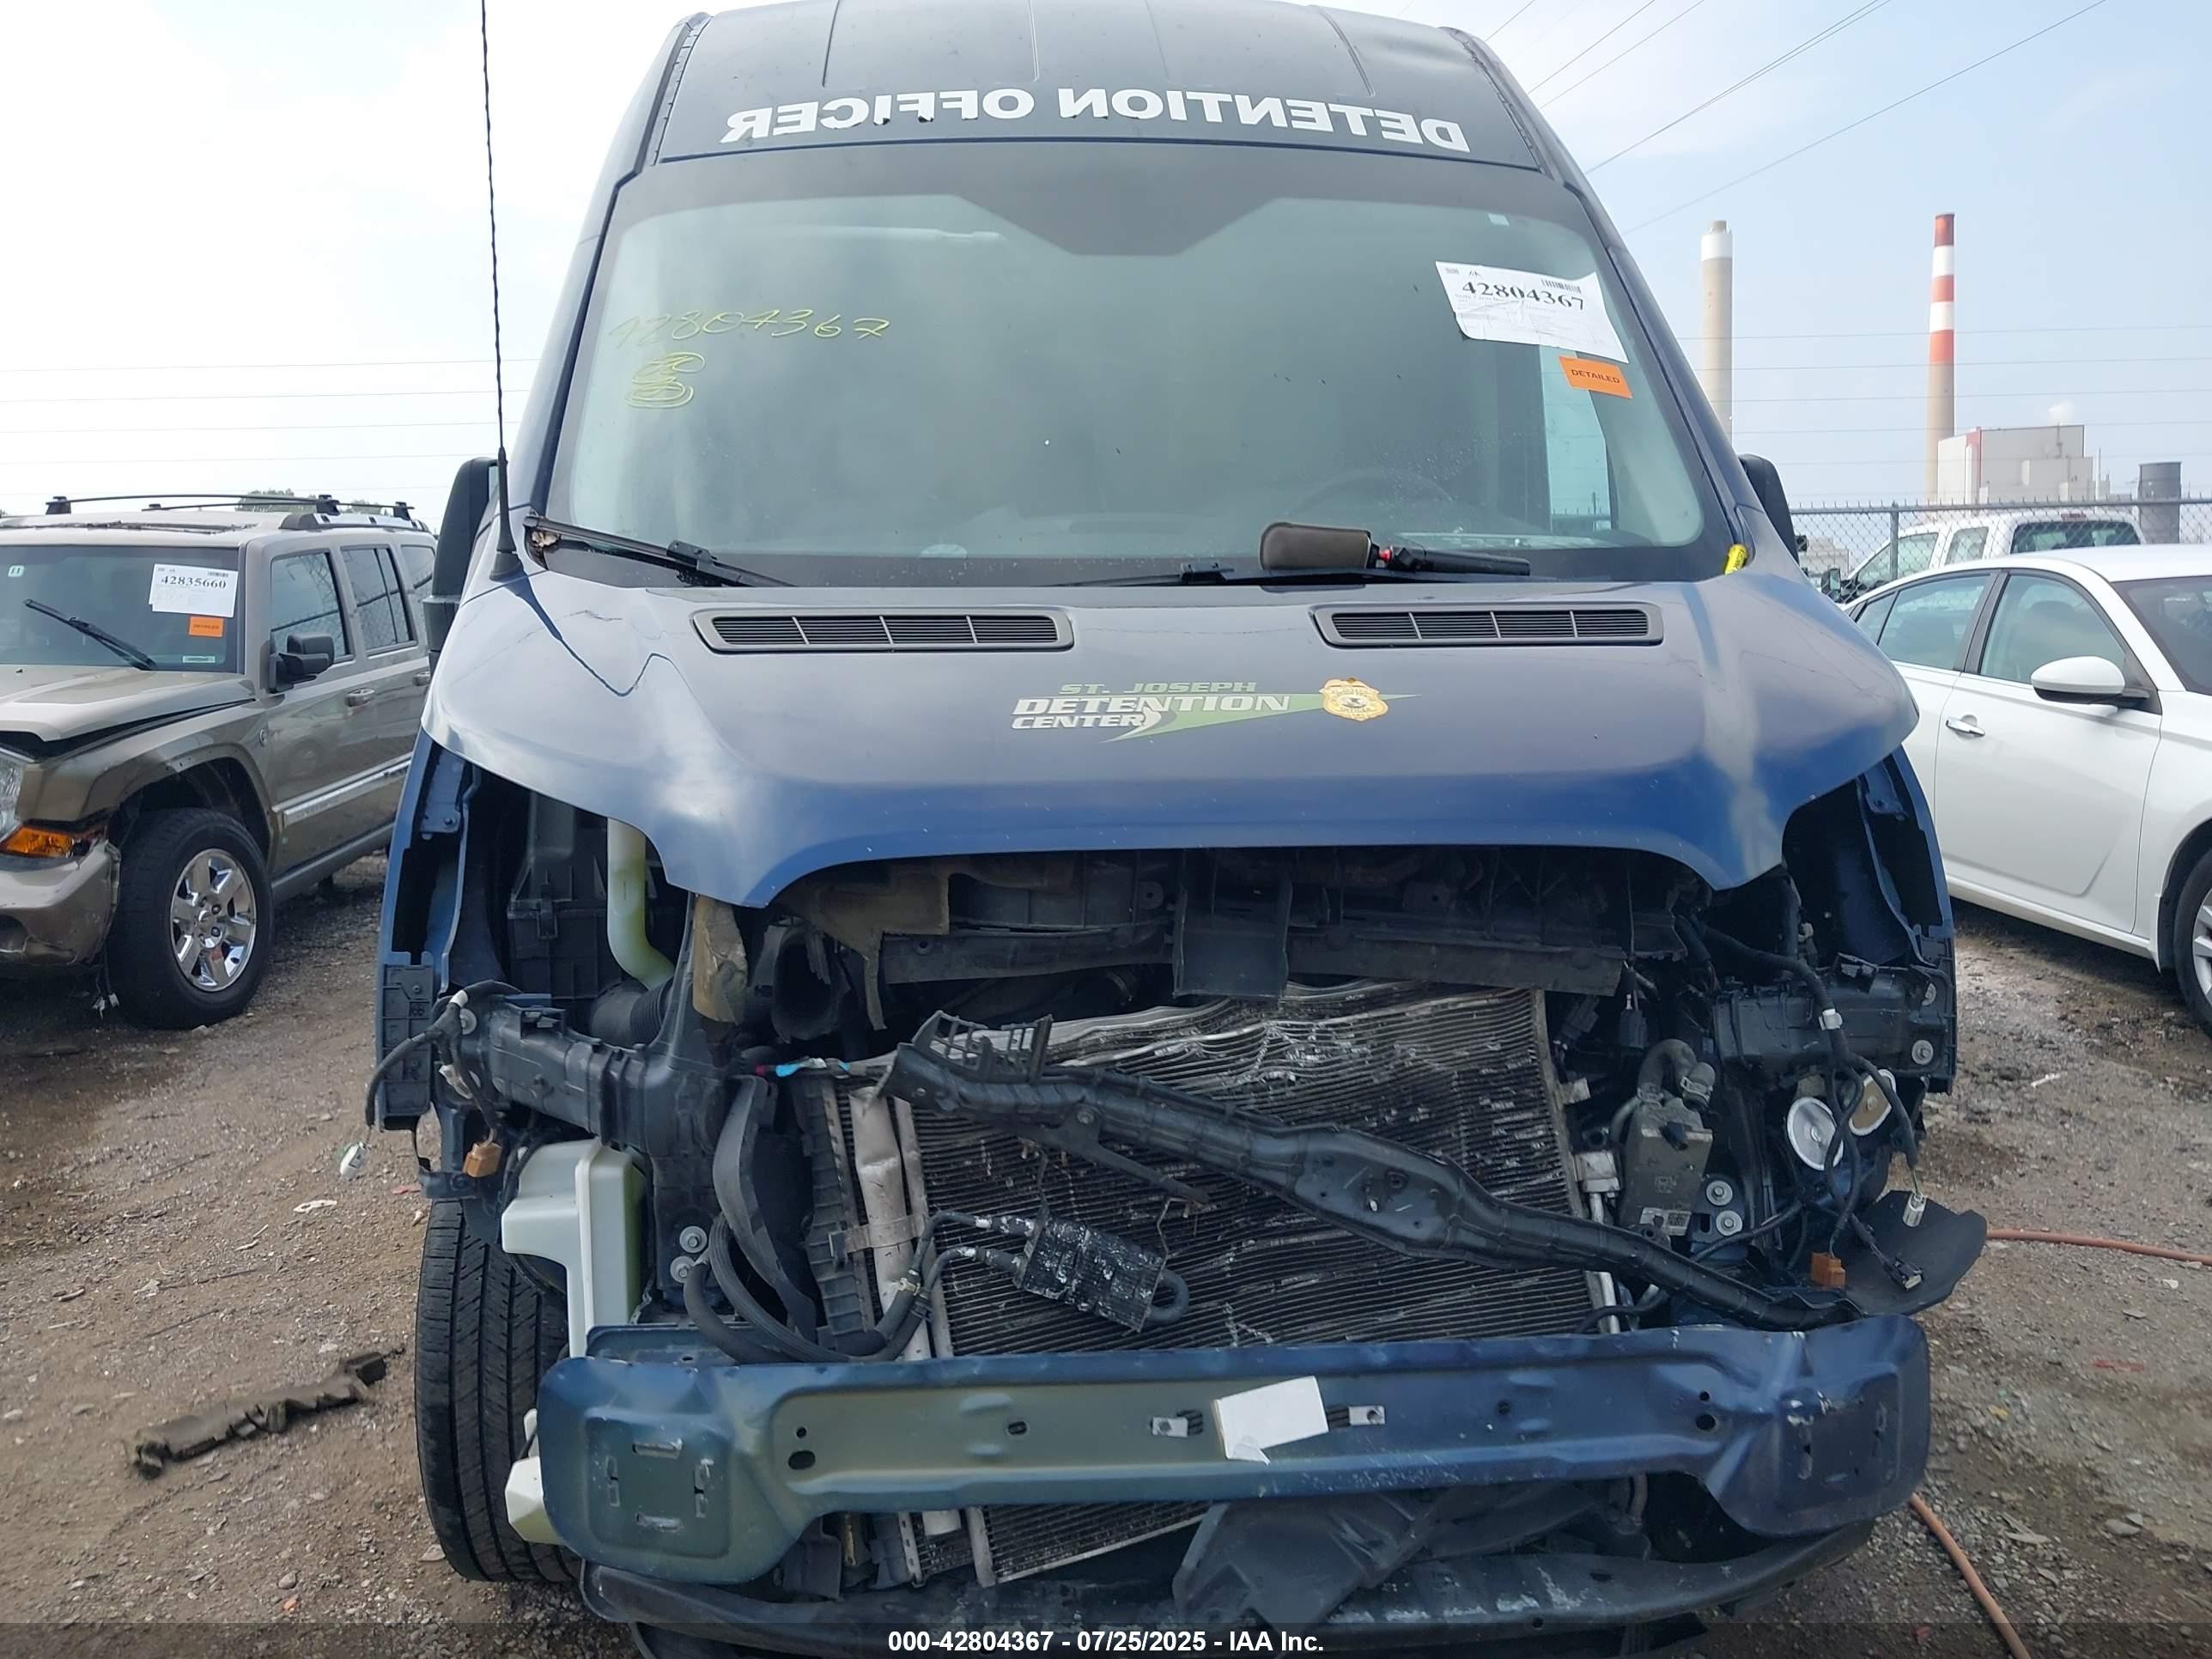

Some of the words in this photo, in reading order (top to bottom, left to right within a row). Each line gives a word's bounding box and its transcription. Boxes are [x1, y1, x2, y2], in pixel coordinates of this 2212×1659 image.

[1462, 281, 1584, 311] 42804367
[1571, 369, 1620, 384] DETAILED
[161, 575, 227, 589] 42835660
[1059, 684, 1110, 695] ST.
[1123, 682, 1258, 694] JOSEPH
[1011, 696, 1291, 715] DETENTION
[1012, 714, 1145, 729] CENTER
